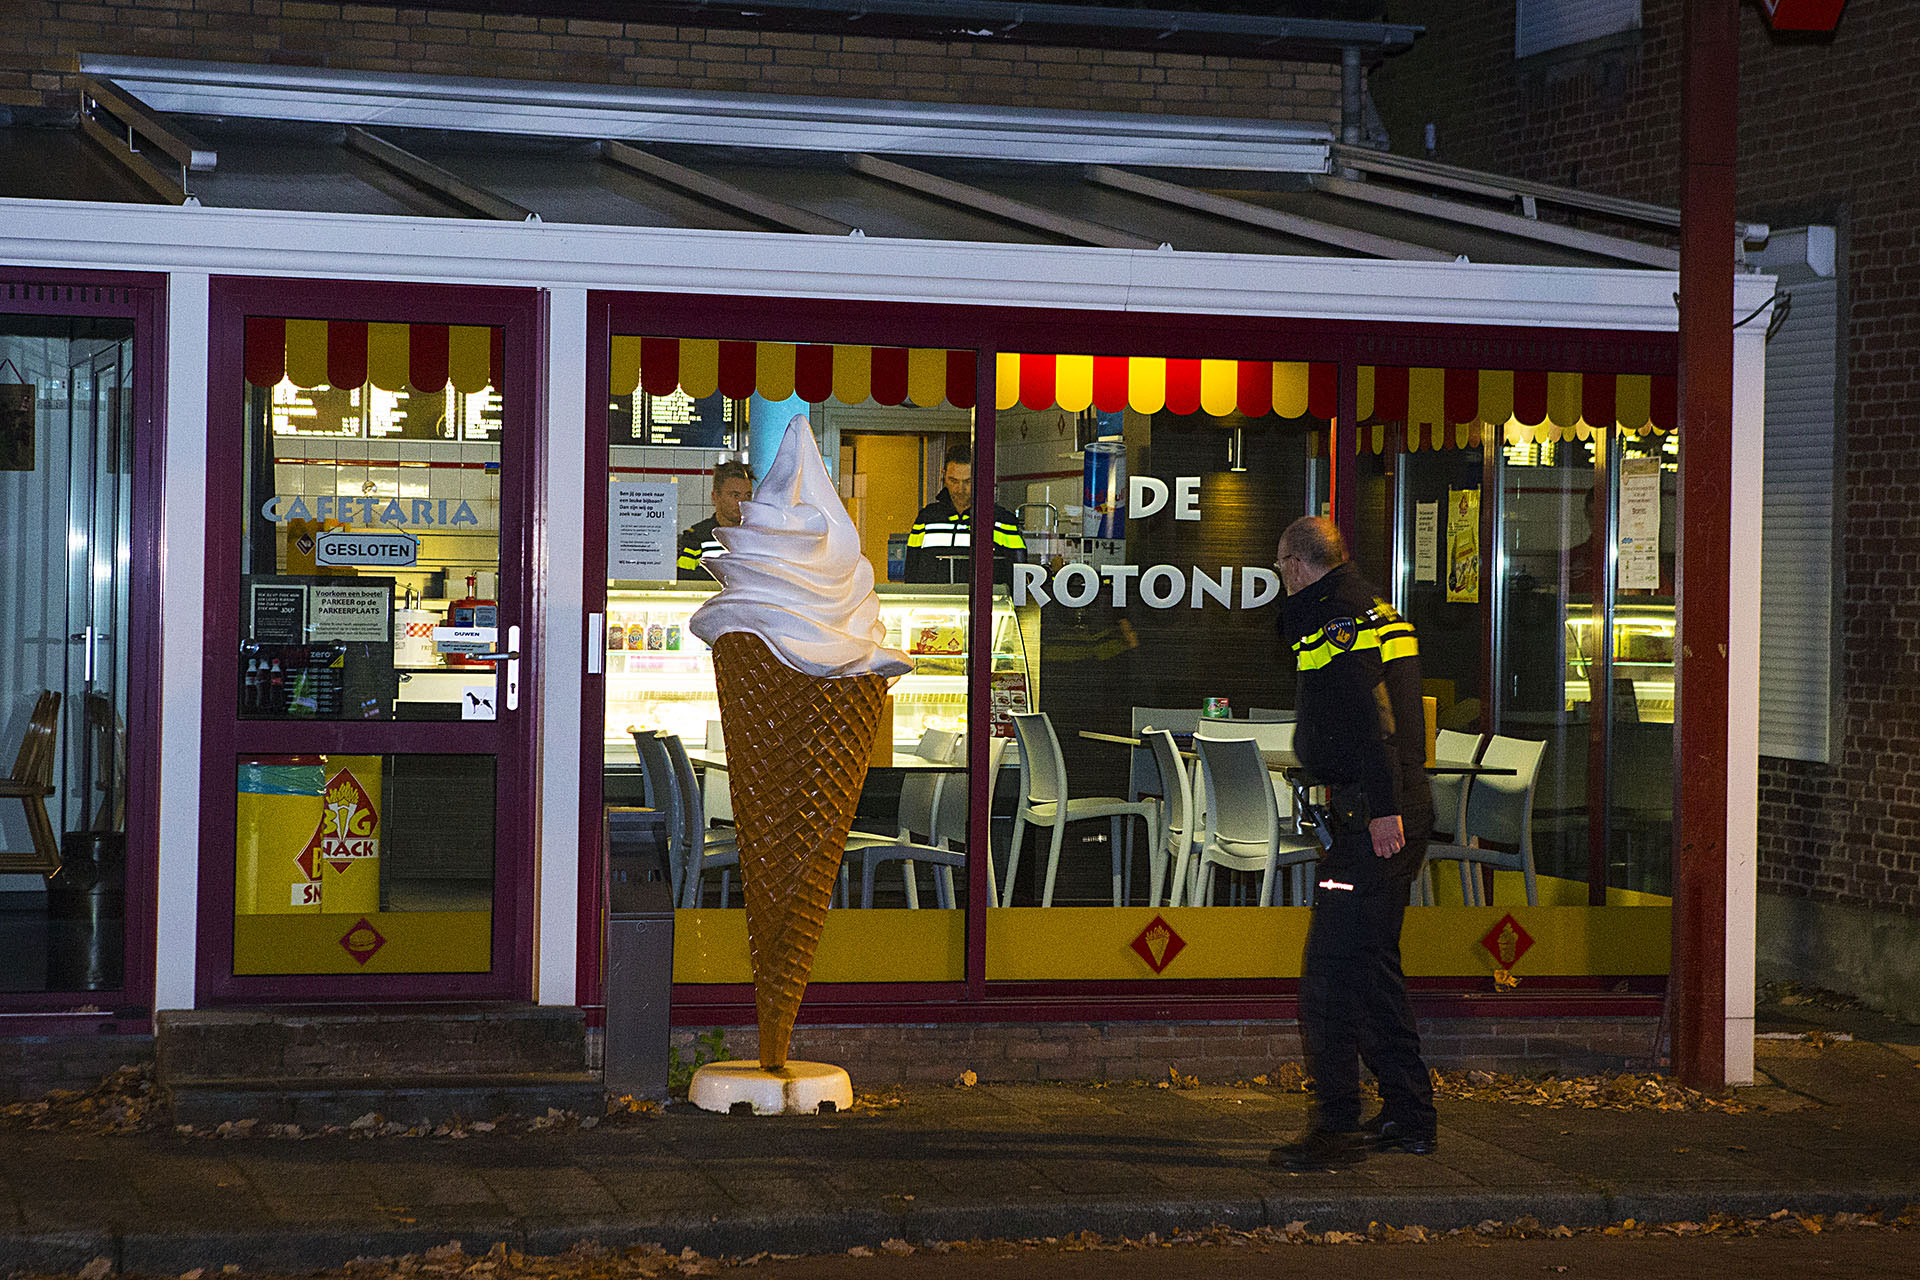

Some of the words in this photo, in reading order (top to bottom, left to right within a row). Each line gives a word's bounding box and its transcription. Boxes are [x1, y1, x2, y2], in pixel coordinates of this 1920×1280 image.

[1128, 475, 1201, 521] DE
[261, 496, 478, 525] CAFETARIA
[646, 511, 665, 519] JOU!
[324, 543, 410, 557] GESLOTEN
[318, 607, 380, 615] PARKEERPLAATS
[310, 650, 331, 659] zero
